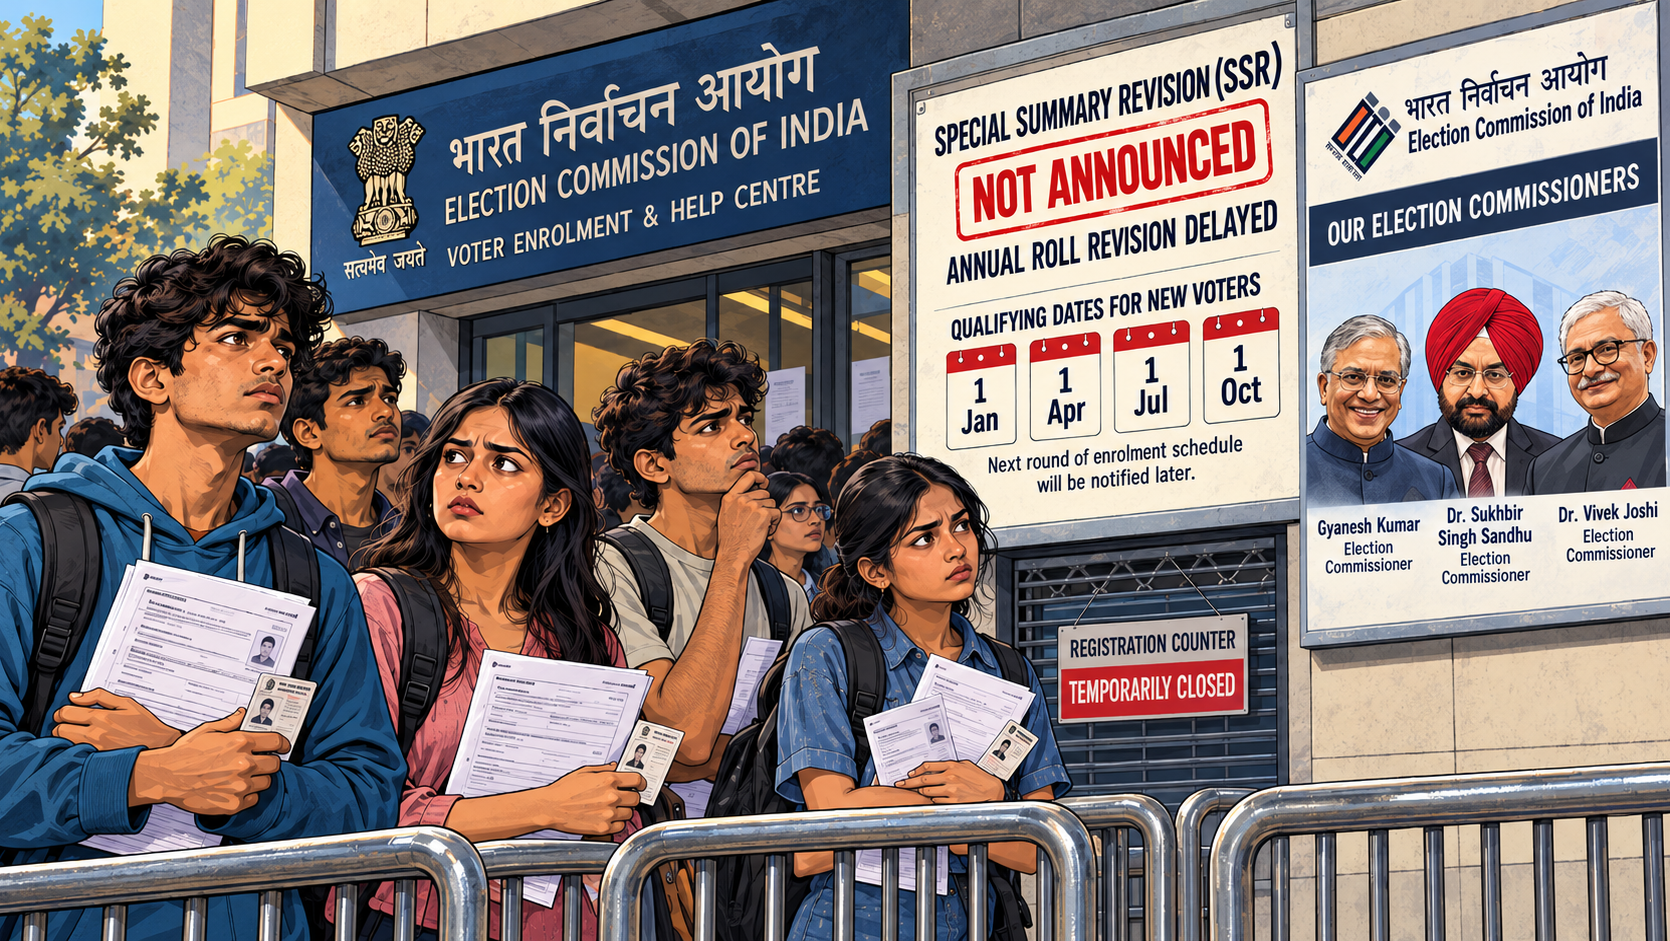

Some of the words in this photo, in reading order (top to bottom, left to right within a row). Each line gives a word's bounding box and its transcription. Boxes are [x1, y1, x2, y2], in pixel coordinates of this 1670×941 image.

[935, 112, 1010, 156] SPECIAL
[1016, 87, 1112, 137] SUMMARY
[1119, 65, 1209, 116] REVISION
[1216, 41, 1282, 101] (SSR)
[1405, 91, 1451, 120] भारत
[1460, 70, 1530, 110] निर्वाचन
[1541, 52, 1608, 90] आयोग
[450, 122, 527, 174] भारत
[539, 82, 680, 156] निर्वाचन
[695, 43, 820, 112] आयोग
[1409, 122, 1469, 153] Election
[1476, 102, 1571, 139] Commission
[1578, 93, 1594, 118] of
[1601, 85, 1642, 114] India
[444, 175, 545, 225] ELECTION
[557, 134, 717, 196] COMMISSION
[731, 121, 769, 159] OF
[781, 98, 870, 149] INDIA
[973, 164, 1036, 223] NOT
[1048, 120, 1256, 209] ANNOUNCED
[447, 237, 504, 267] VOTER
[515, 209, 632, 254] ENROLMENT
[644, 205, 658, 227] &
[670, 191, 723, 222] HELP
[735, 169, 820, 209] CENTRE
[1328, 217, 1364, 246] OUR
[1373, 198, 1461, 238] ELECTION
[1469, 162, 1640, 220] COMMISSIONERS
[393, 241, 426, 269] जयते
[947, 245, 1025, 285] ANNUAL
[1033, 236, 1080, 270] ROLL
[1088, 218, 1175, 261] REVISION
[1186, 200, 1277, 245] DELAYED
[952, 307, 1046, 341] QUALIFYING
[1053, 298, 1104, 325] DATES
[1110, 292, 1141, 317] FOR
[1148, 285, 1187, 312] NEW
[1193, 272, 1260, 305] VOTERS
[1145, 357, 1158, 383] 1
[1234, 345, 1247, 372] 1
[975, 378, 986, 403] 1
[1059, 367, 1072, 393] 1
[1222, 377, 1262, 406] Oct
[1048, 399, 1085, 429] Apr
[1134, 385, 1167, 416] Jul
[962, 409, 998, 434] Jan
[989, 456, 1021, 473] Next
[1027, 450, 1069, 470] round
[1075, 448, 1089, 466] of
[1094, 443, 1166, 464] enrolment
[1173, 435, 1242, 457] schedule
[1037, 475, 1061, 493] will
[1068, 471, 1085, 490] be
[1090, 467, 1149, 488] notified
[1156, 464, 1195, 483] later.
[1448, 508, 1465, 523] Dr.
[1471, 504, 1523, 522] Sukhbir
[1559, 507, 1577, 522] Dr.
[1584, 503, 1619, 521] Vivek
[1624, 501, 1657, 519] Joshi
[1318, 517, 1371, 539] Gyanesh
[1378, 517, 1420, 533] Kumar
[1439, 528, 1476, 549] Singh
[1482, 526, 1531, 544] Sandhu
[1584, 528, 1633, 543] Election
[1345, 541, 1393, 555] Election
[1461, 551, 1510, 566] Election
[1567, 545, 1655, 562] Commissioner
[1326, 559, 1412, 574] Commissioner
[1442, 569, 1530, 584] Commissioner
[1071, 634, 1166, 658] REGISTRATION
[1172, 630, 1235, 652] COUNTER
[1069, 676, 1172, 704] TEMPORARILY
[1178, 673, 1235, 698] CLOSED
